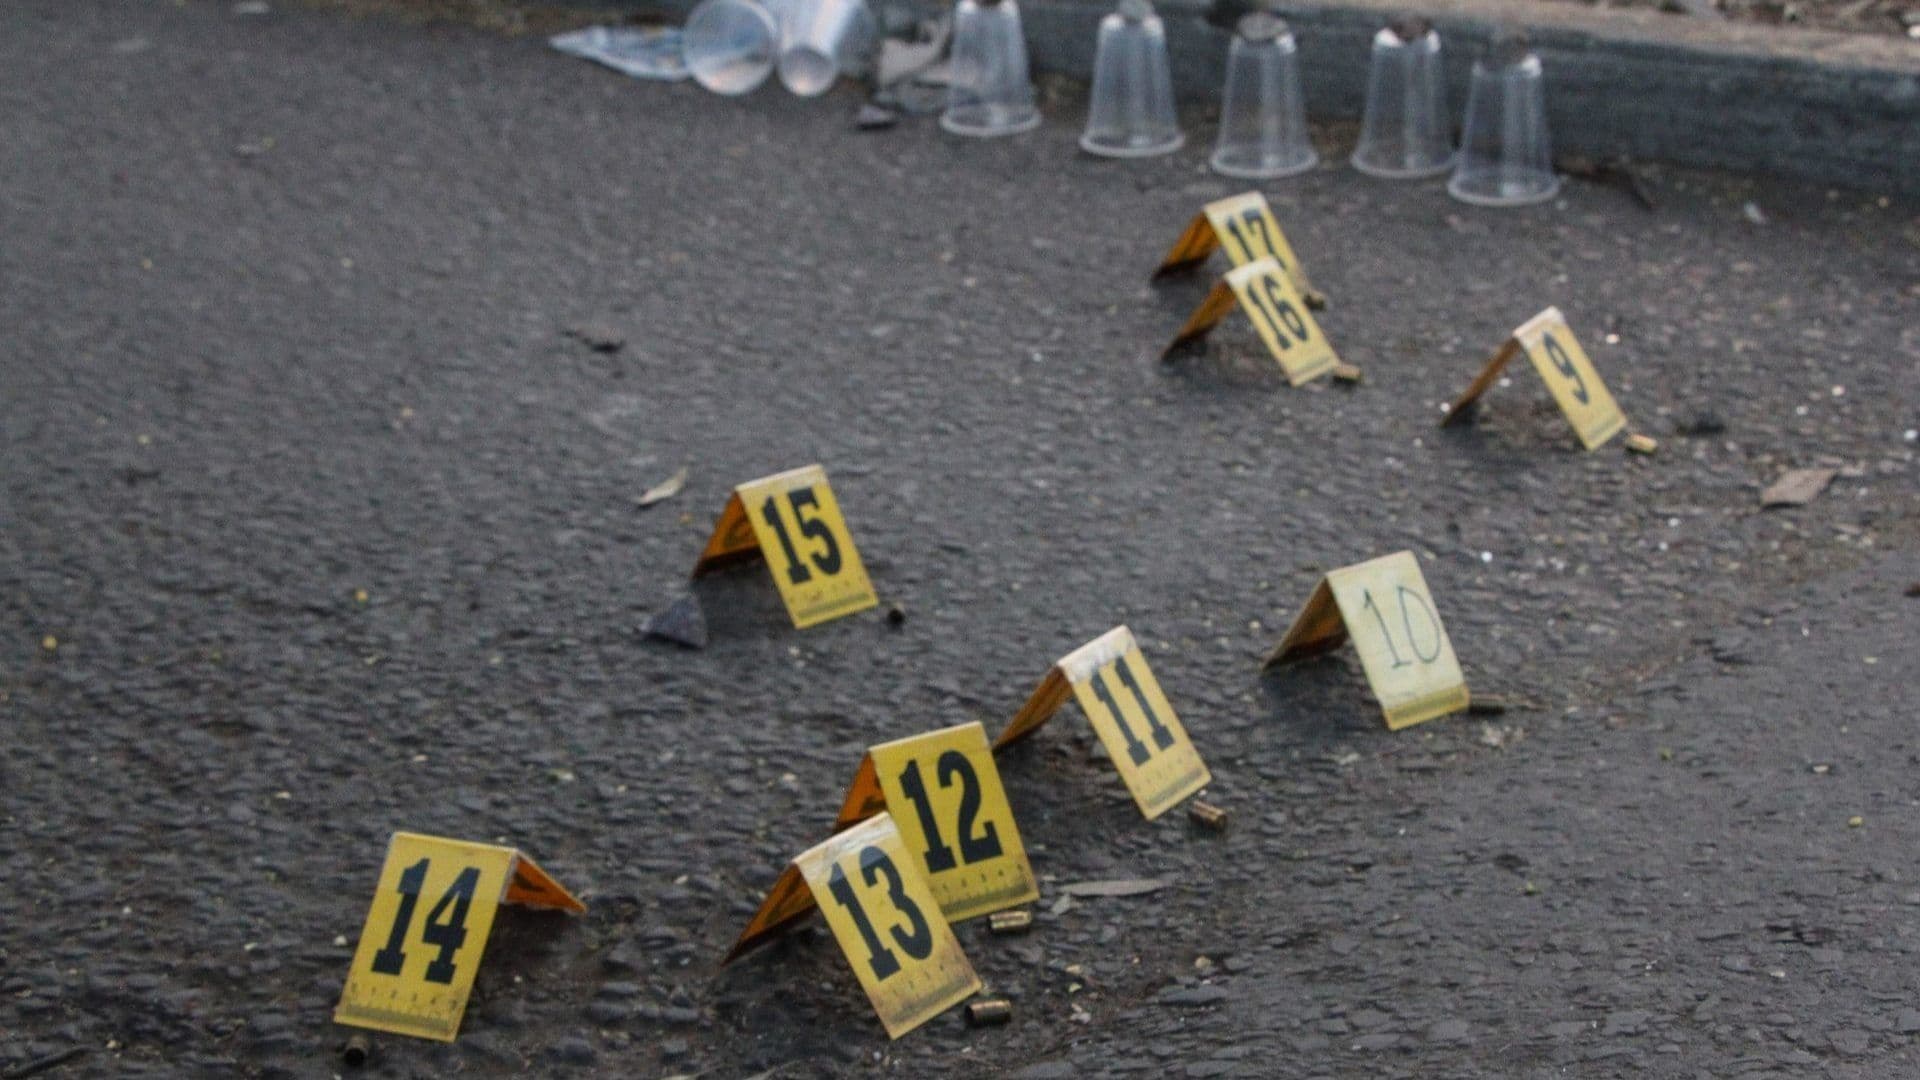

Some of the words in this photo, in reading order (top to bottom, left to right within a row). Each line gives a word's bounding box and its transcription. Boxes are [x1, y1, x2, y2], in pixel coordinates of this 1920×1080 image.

[1226, 209, 1288, 272] 17
[1246, 274, 1308, 350] 16
[1543, 331, 1589, 405] 9
[762, 487, 842, 584] 15
[1363, 584, 1441, 668] 10
[1091, 656, 1175, 767] 11
[899, 749, 1004, 874] 12
[371, 858, 481, 985] 14
[828, 846, 933, 982] 13
